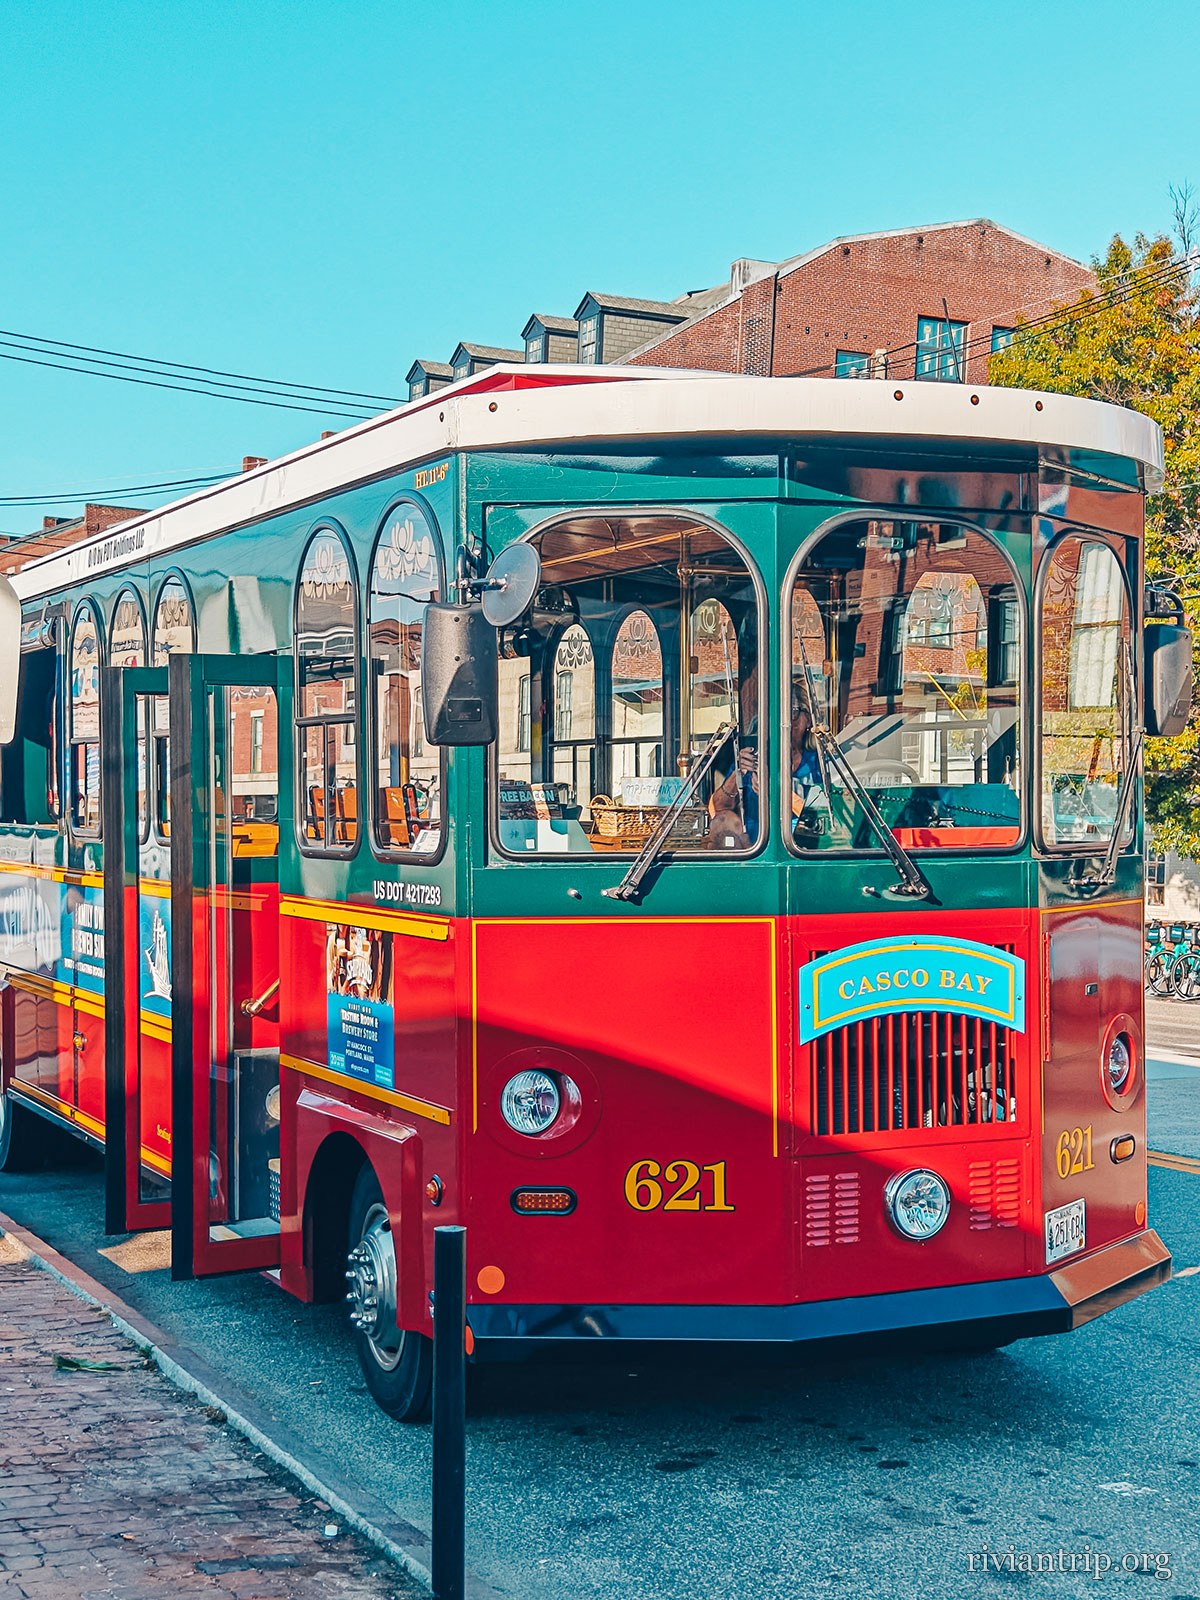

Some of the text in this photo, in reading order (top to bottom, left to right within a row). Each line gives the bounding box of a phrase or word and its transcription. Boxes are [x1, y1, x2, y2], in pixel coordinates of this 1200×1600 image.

[135, 528, 145, 550] LLC
[519, 789, 555, 802] BACON
[373, 880, 441, 906] US DOT 4217293
[838, 968, 993, 1000] CASCO BAY
[341, 1022, 378, 1042] BREWERY STORE
[1055, 1124, 1095, 1179] 621
[623, 1158, 737, 1213] 621
